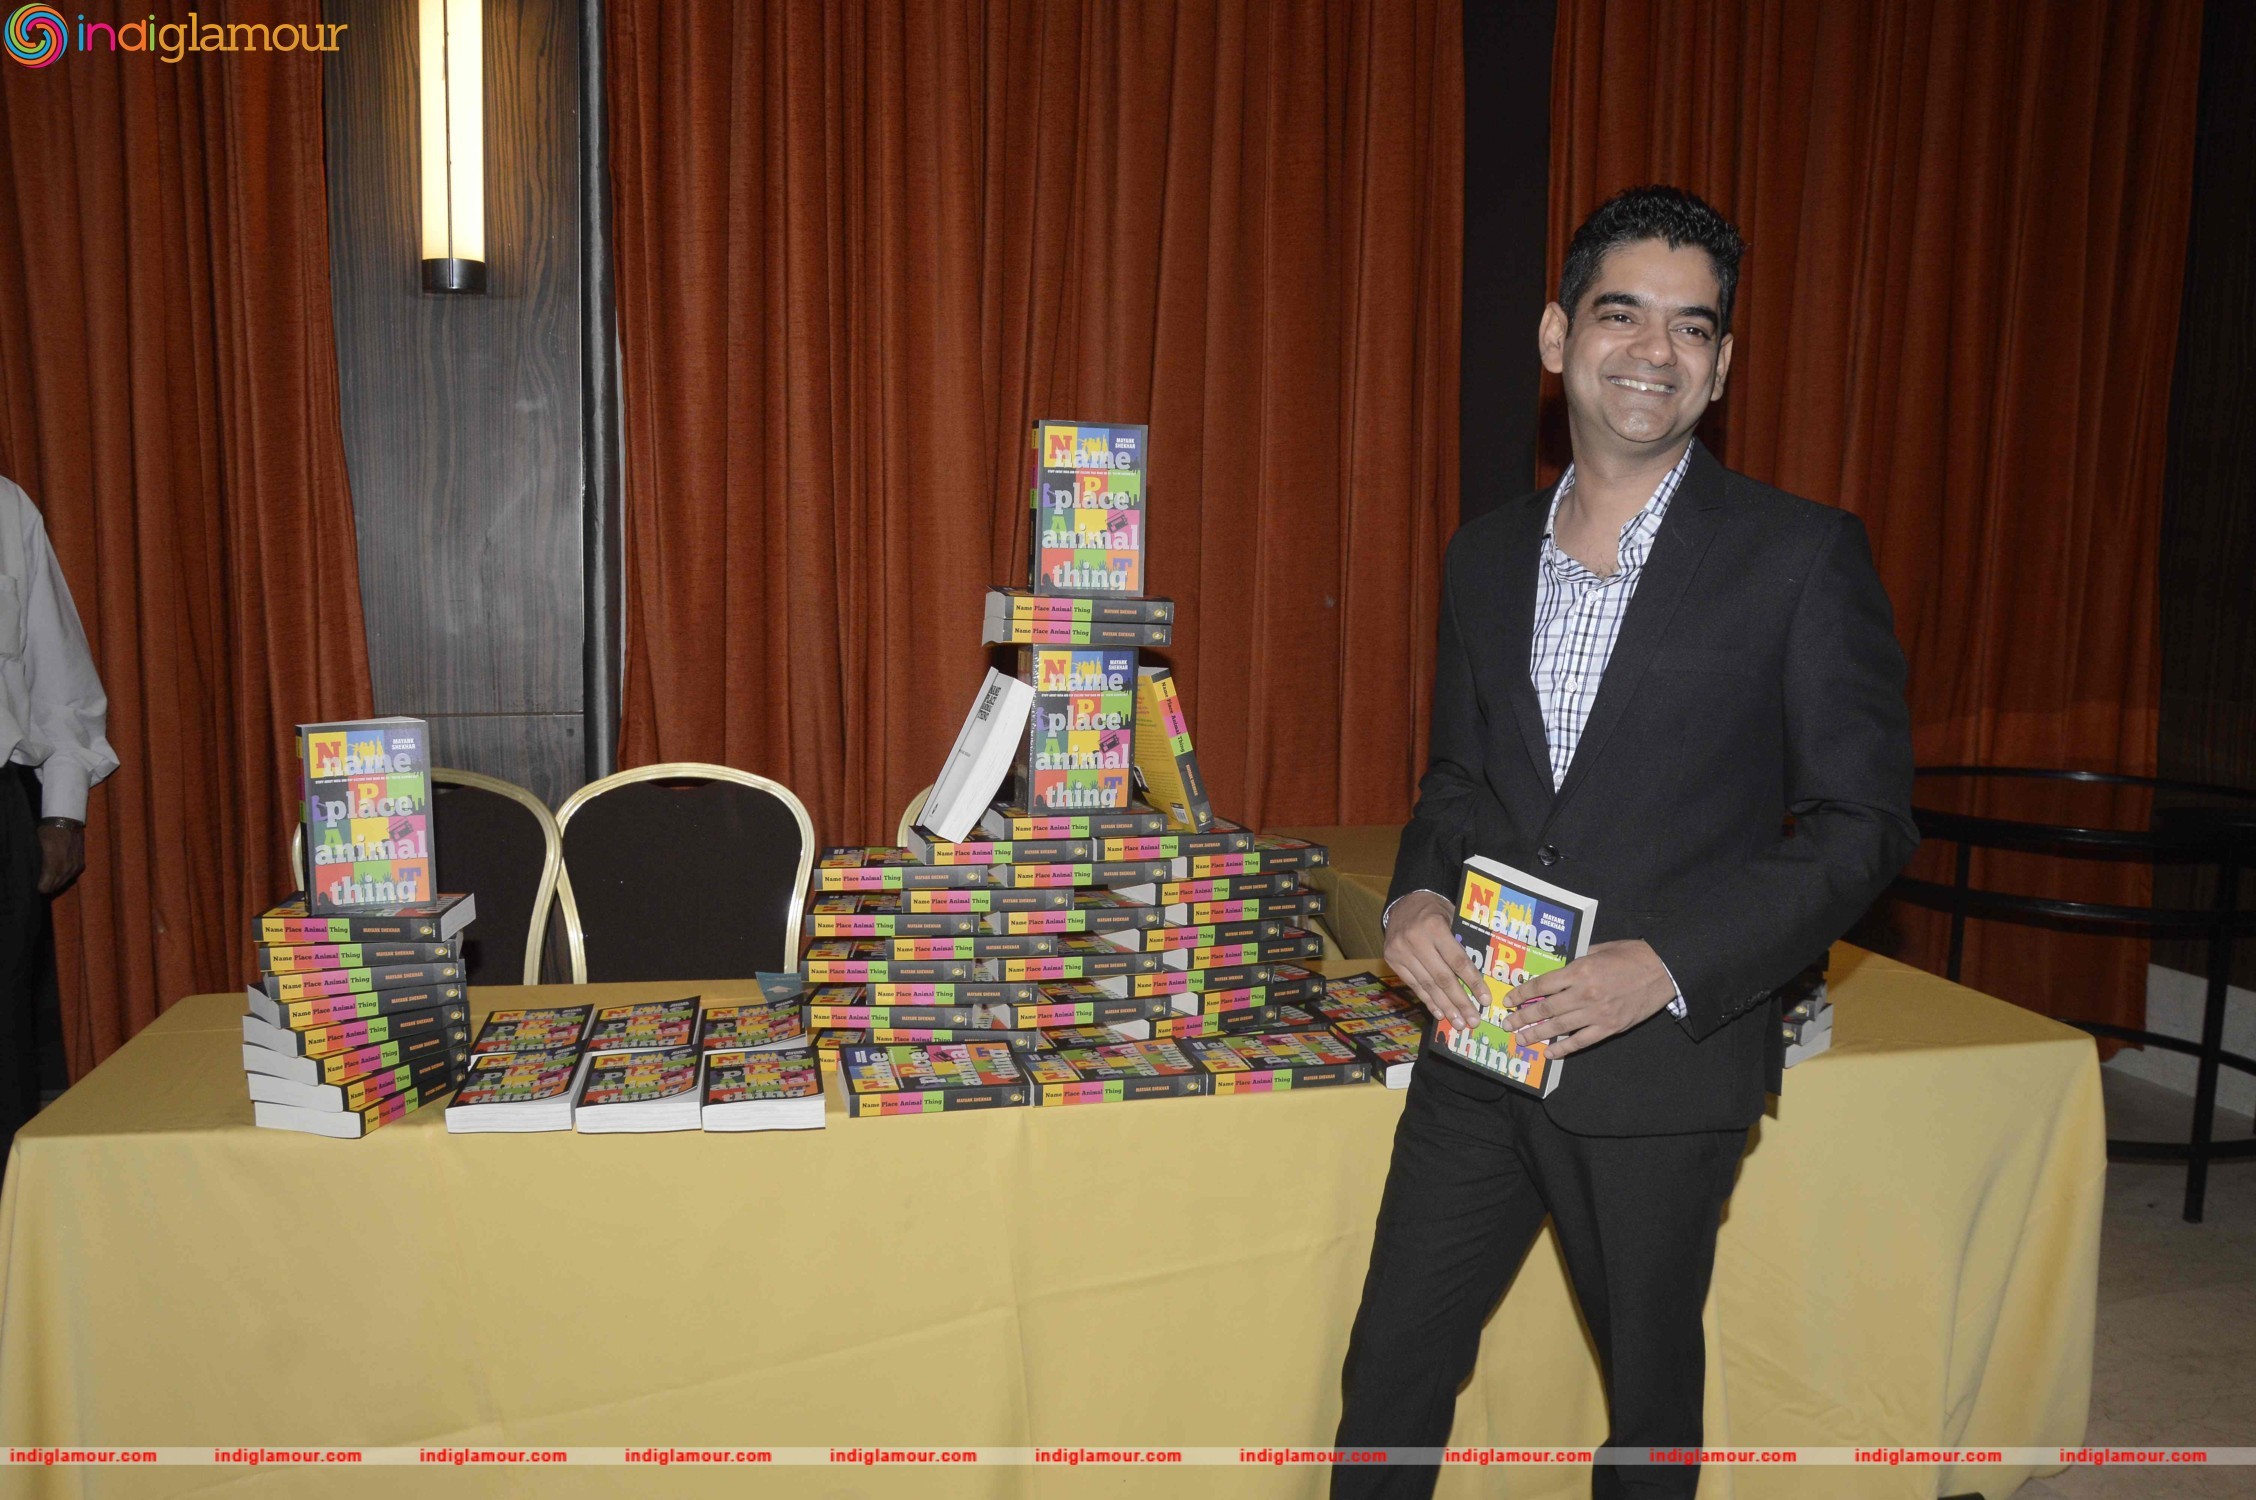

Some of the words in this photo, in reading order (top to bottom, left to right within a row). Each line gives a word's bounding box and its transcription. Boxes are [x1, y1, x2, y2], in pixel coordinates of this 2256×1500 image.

[1055, 449, 1131, 469] name
[1054, 482, 1130, 514] place
[1042, 523, 1139, 550] animal
[1053, 561, 1127, 591] thing
[1074, 606, 1091, 614] Thing
[1072, 629, 1089, 637] Thing
[1049, 672, 1124, 691] name
[1048, 705, 1122, 737] place
[323, 752, 412, 777] name
[1035, 744, 1130, 770] animal
[1046, 782, 1118, 808] thing
[326, 791, 413, 828] place
[315, 830, 429, 865] animal
[330, 875, 417, 906] thing
[1470, 900, 1558, 952] name
[1540, 918, 1566, 932] SHEKHAR
[1542, 912, 1566, 925] MAYANK
[329, 926, 349, 934] Thing
[314, 952, 339, 960] Animal
[340, 952, 361, 960] Thing
[955, 944, 973, 952] Thing
[323, 978, 348, 986] Animal
[308, 1037, 326, 1045] Name
[327, 1034, 344, 1042] Place
[345, 1029, 368, 1039] Animal
[369, 1027, 387, 1035] Thing
[1447, 1028, 1530, 1084] thing
[1252, 1077, 1273, 1085] Animal
